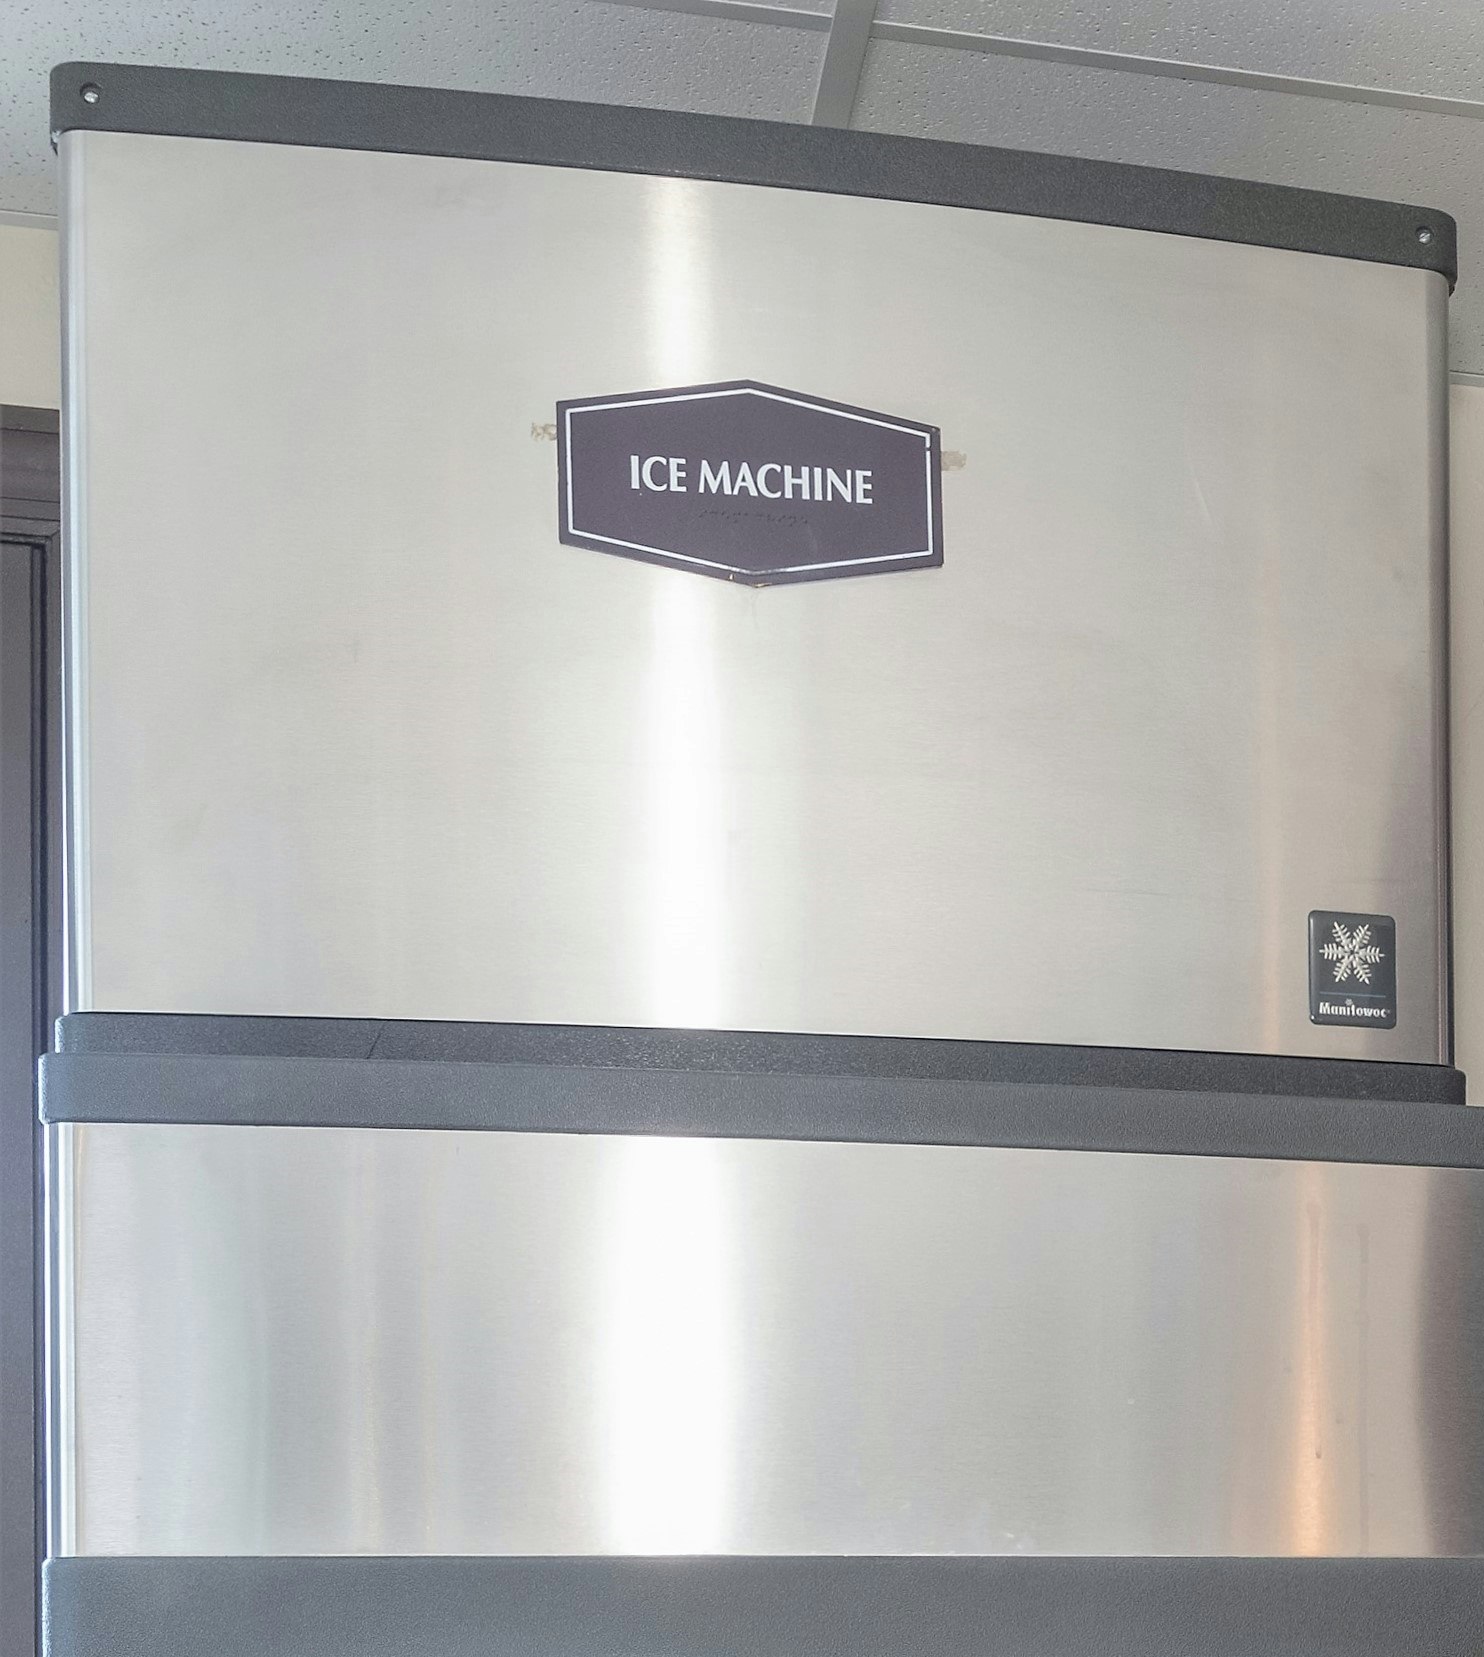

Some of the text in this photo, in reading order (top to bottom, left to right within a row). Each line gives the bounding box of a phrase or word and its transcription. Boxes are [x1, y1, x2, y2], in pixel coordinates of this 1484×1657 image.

[630, 454, 874, 505] ICE MACHINE
[1319, 1001, 1387, 1018] Manitowoc
